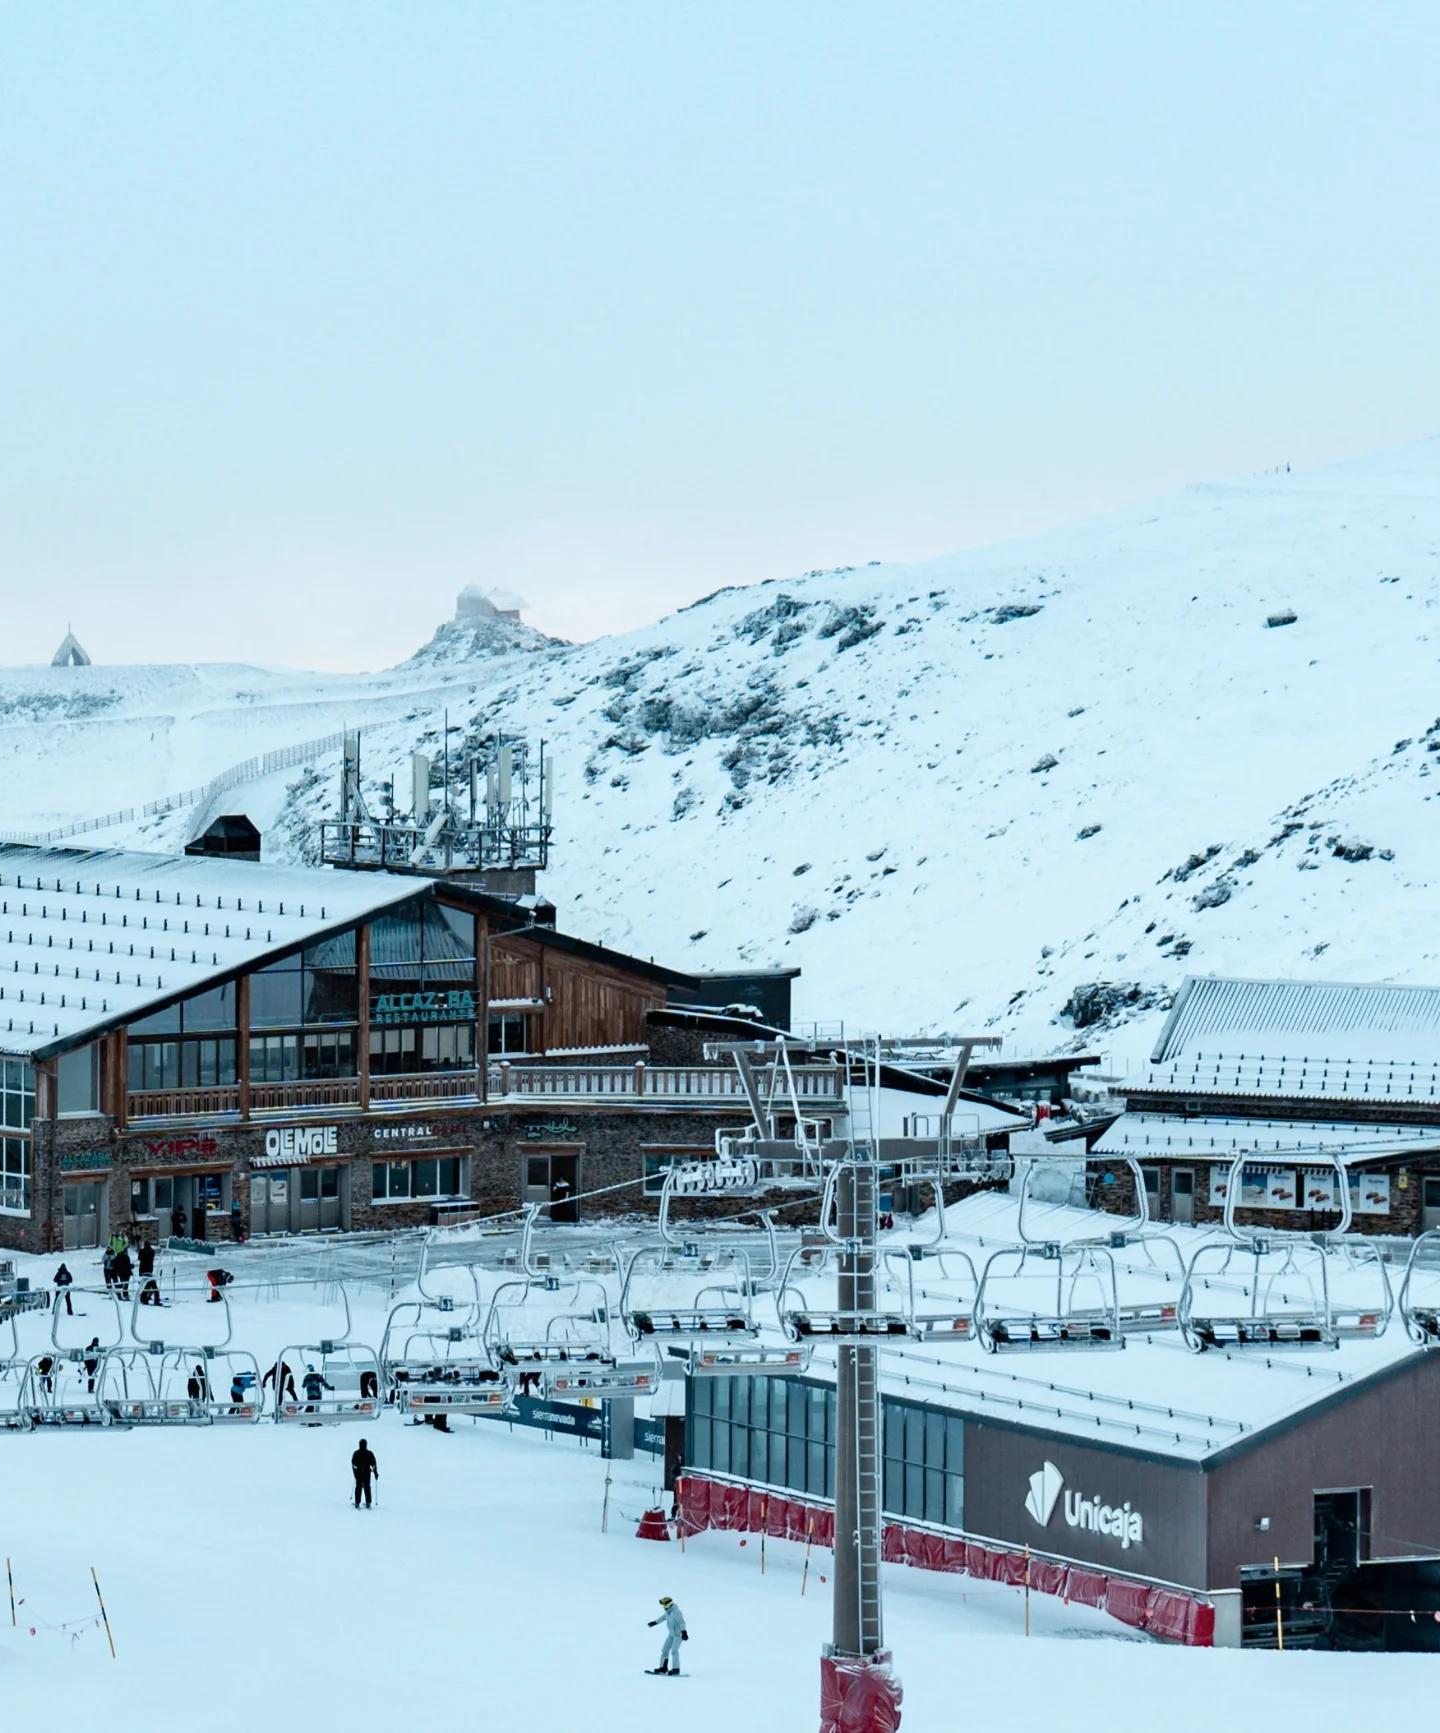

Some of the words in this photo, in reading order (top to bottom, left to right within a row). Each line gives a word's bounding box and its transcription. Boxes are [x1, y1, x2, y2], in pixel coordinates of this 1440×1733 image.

[376, 990, 475, 1012] ALCAZBA
[374, 1126, 432, 1139] CENTRAL
[532, 1408, 576, 1426] sierranevada
[1064, 1489, 1144, 1549] Unicaja
